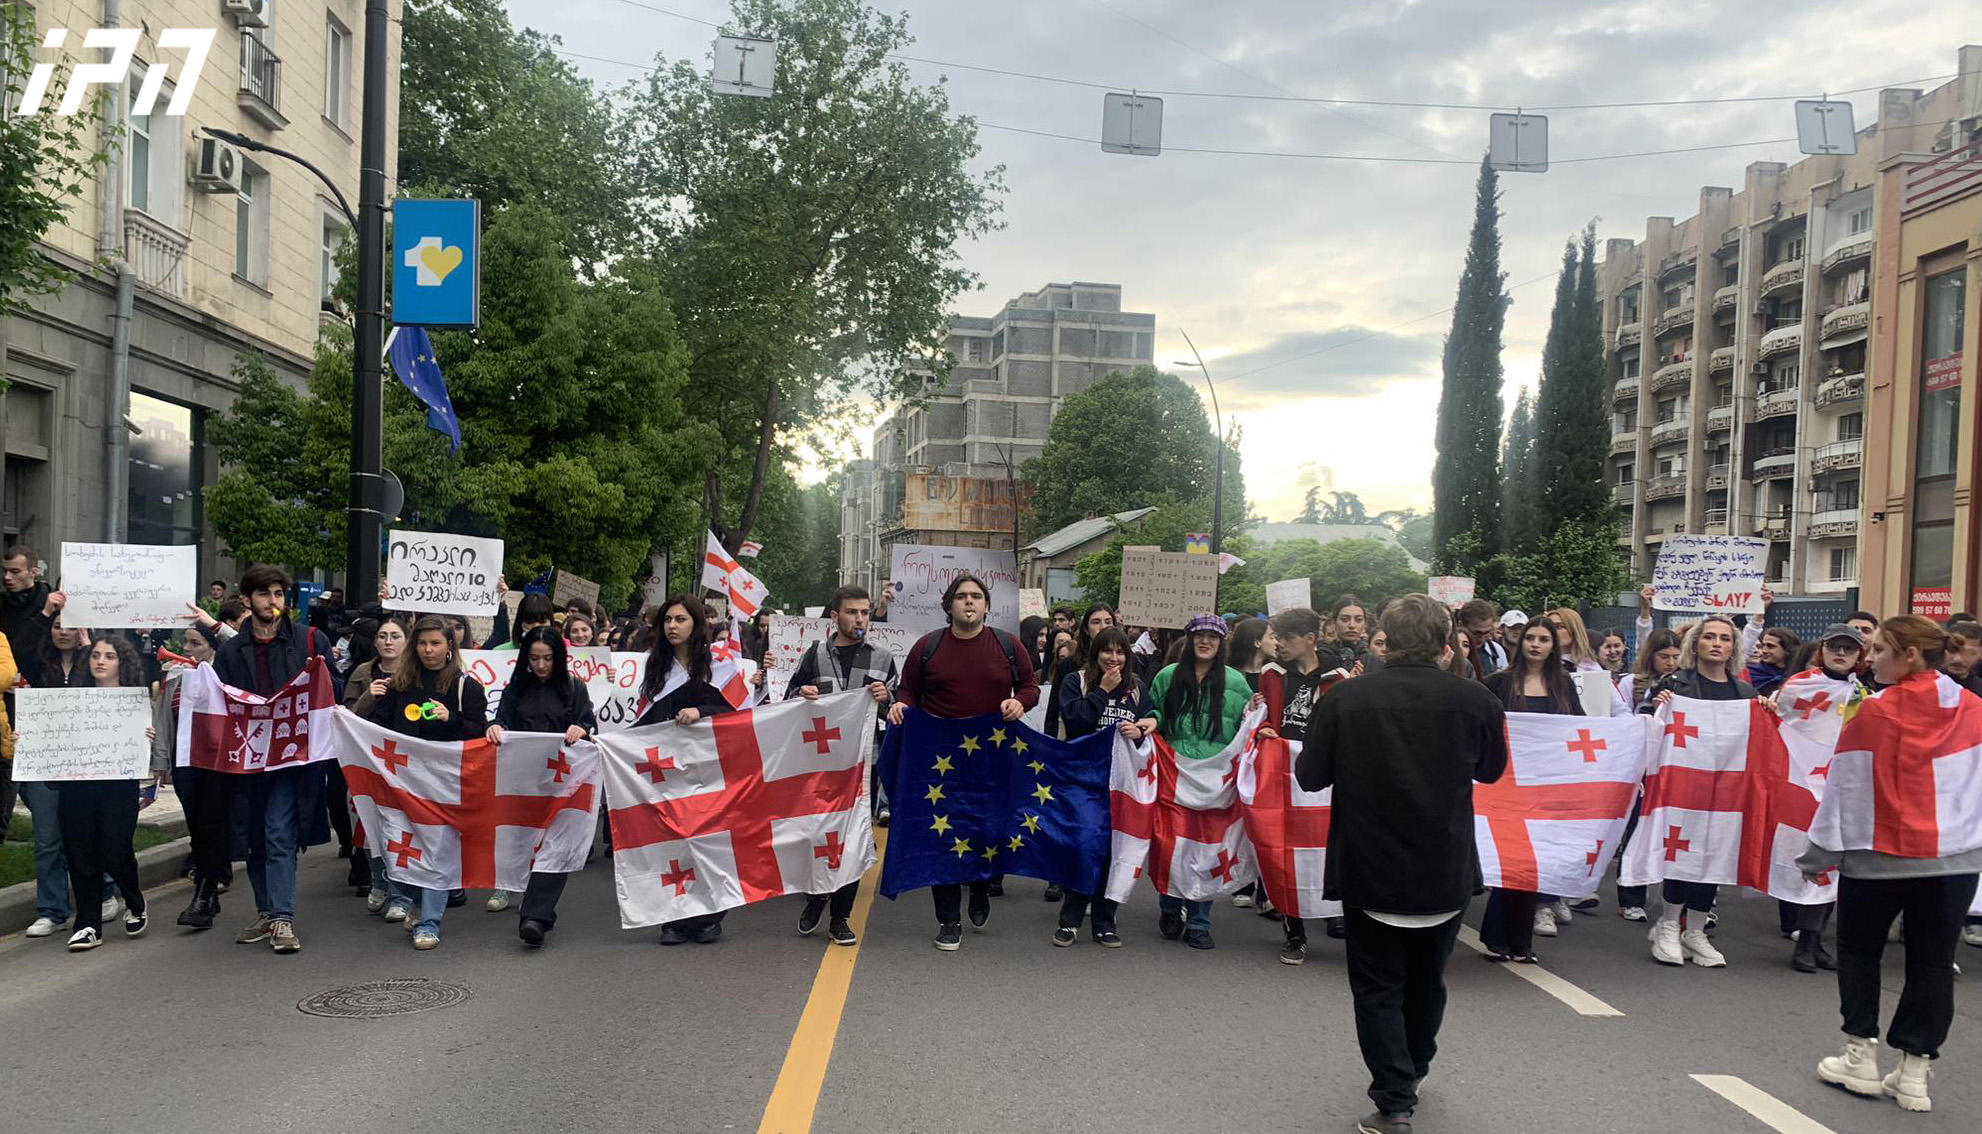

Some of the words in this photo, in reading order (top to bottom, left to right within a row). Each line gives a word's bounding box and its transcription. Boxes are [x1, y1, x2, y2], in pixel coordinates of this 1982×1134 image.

[469, 573, 486, 587] IQ
[1702, 592, 1753, 609] SLAY!
[1925, 606, 1934, 614] 57
